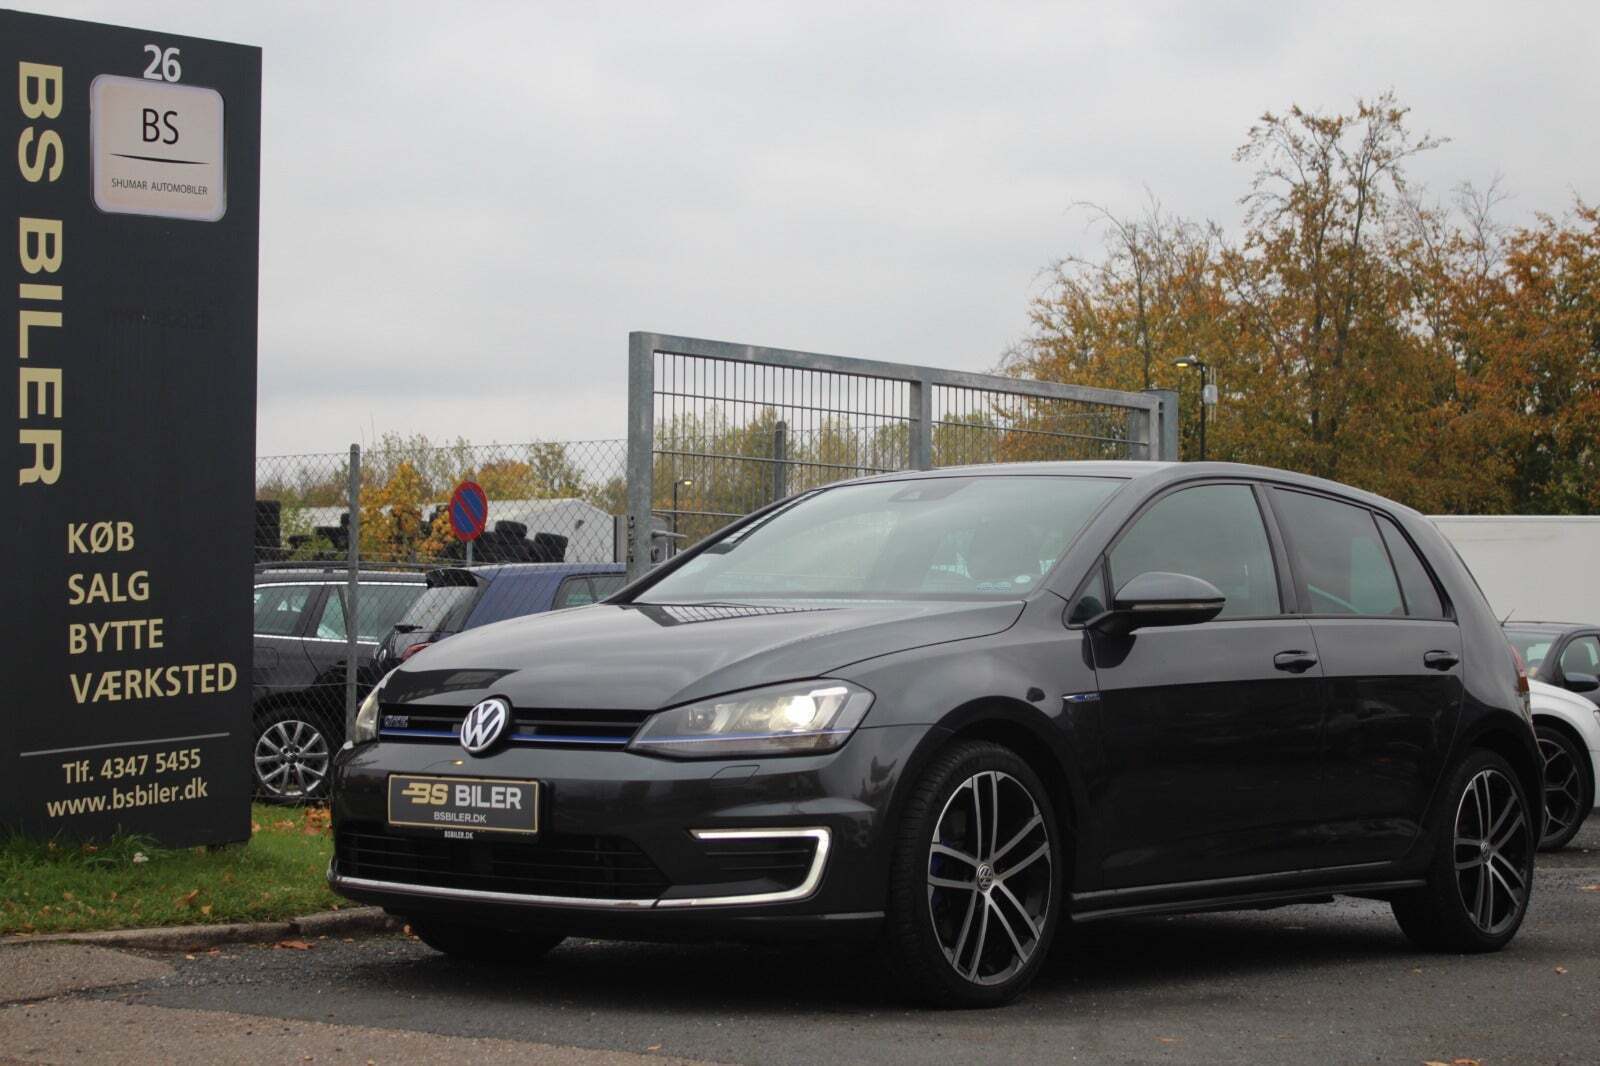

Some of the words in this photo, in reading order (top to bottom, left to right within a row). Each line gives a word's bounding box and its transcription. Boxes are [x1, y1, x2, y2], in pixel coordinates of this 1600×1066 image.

[143, 44, 182, 83] 26
[18, 60, 64, 183] BS
[141, 107, 180, 145] BS
[111, 177, 148, 191] SHUMAR
[150, 182, 208, 196] AUTOMOBILER
[18, 216, 64, 486] BILER
[67, 520, 135, 555] KØB
[68, 570, 149, 605] SALG
[69, 618, 164, 655] BYTTE
[69, 661, 238, 704] VÆRKSTED
[62, 760, 95, 784] Tlf.
[100, 754, 149, 781] 4347
[155, 748, 201, 774] 5455
[47, 777, 208, 818] www.bsbiler.dk
[402, 782, 449, 806] BS
[455, 784, 522, 810] BILER
[433, 811, 487, 824] BSBILER.DK
[444, 830, 474, 839] BSBILER.DK
